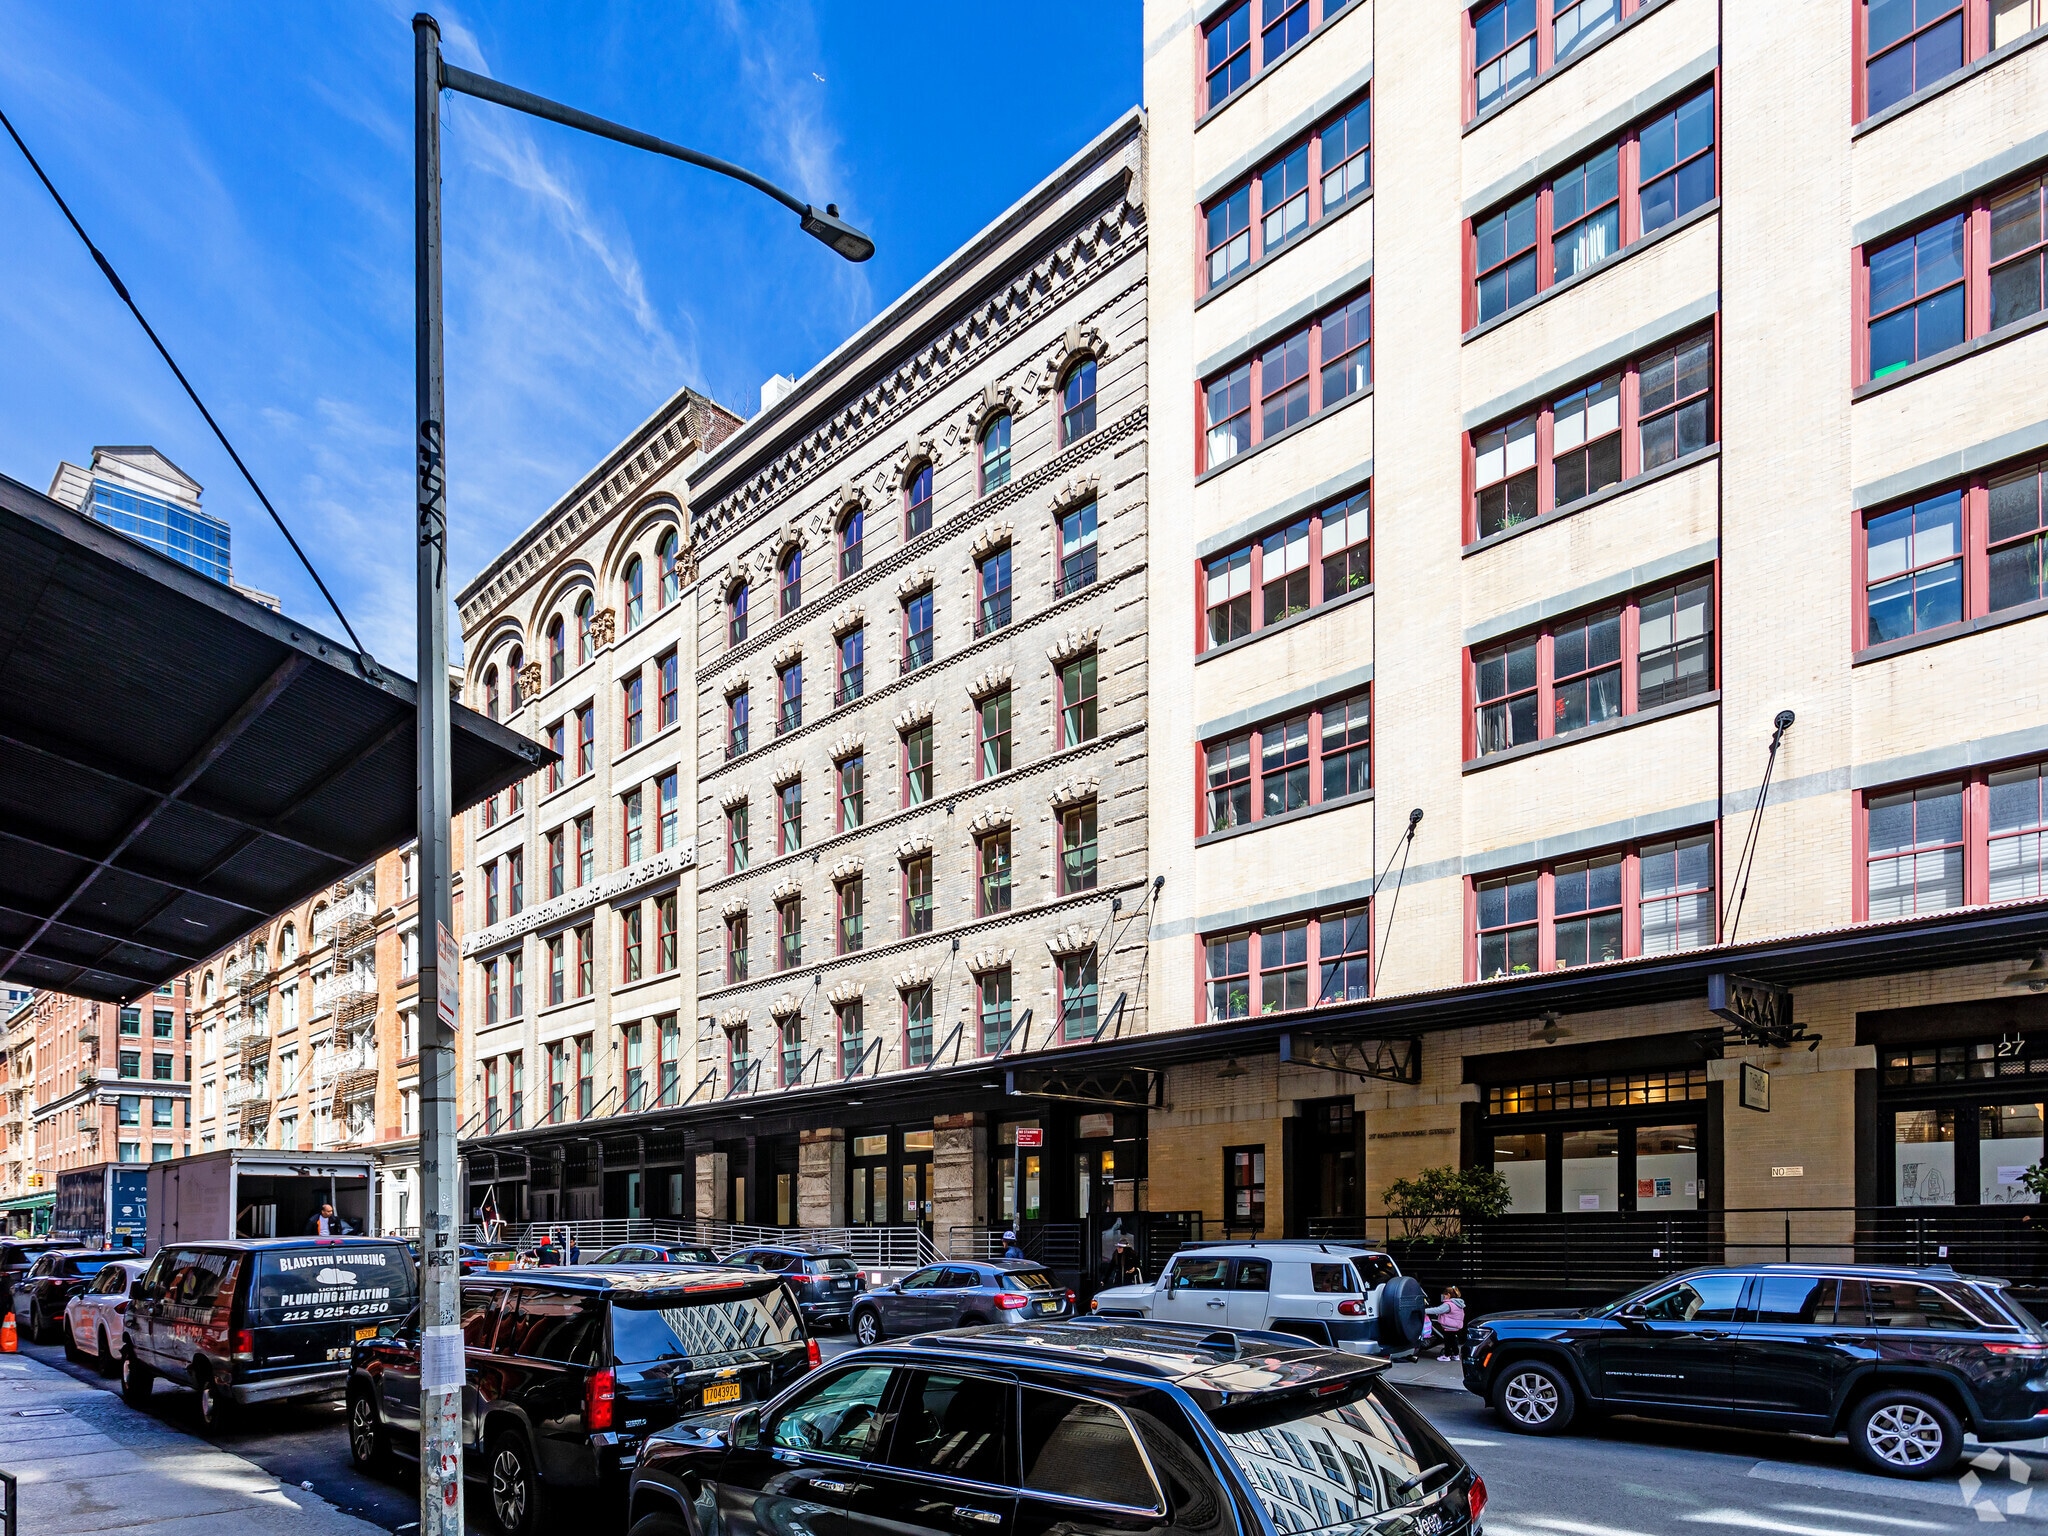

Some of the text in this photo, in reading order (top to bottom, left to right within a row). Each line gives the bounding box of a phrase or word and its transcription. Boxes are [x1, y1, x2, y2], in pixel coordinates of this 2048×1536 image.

[1998, 1040, 2026, 1057] 27
[1772, 1167, 1785, 1176] NO
[279, 1253, 386, 1272] BLAUSTEIN PLUMBING
[280, 1291, 337, 1307] PLUMBING
[345, 1287, 390, 1302] HEATING
[282, 1302, 389, 1322] 212 925-6250
[705, 1384, 738, 1401] T704392C
[1414, 1513, 1443, 1536] Jeep
